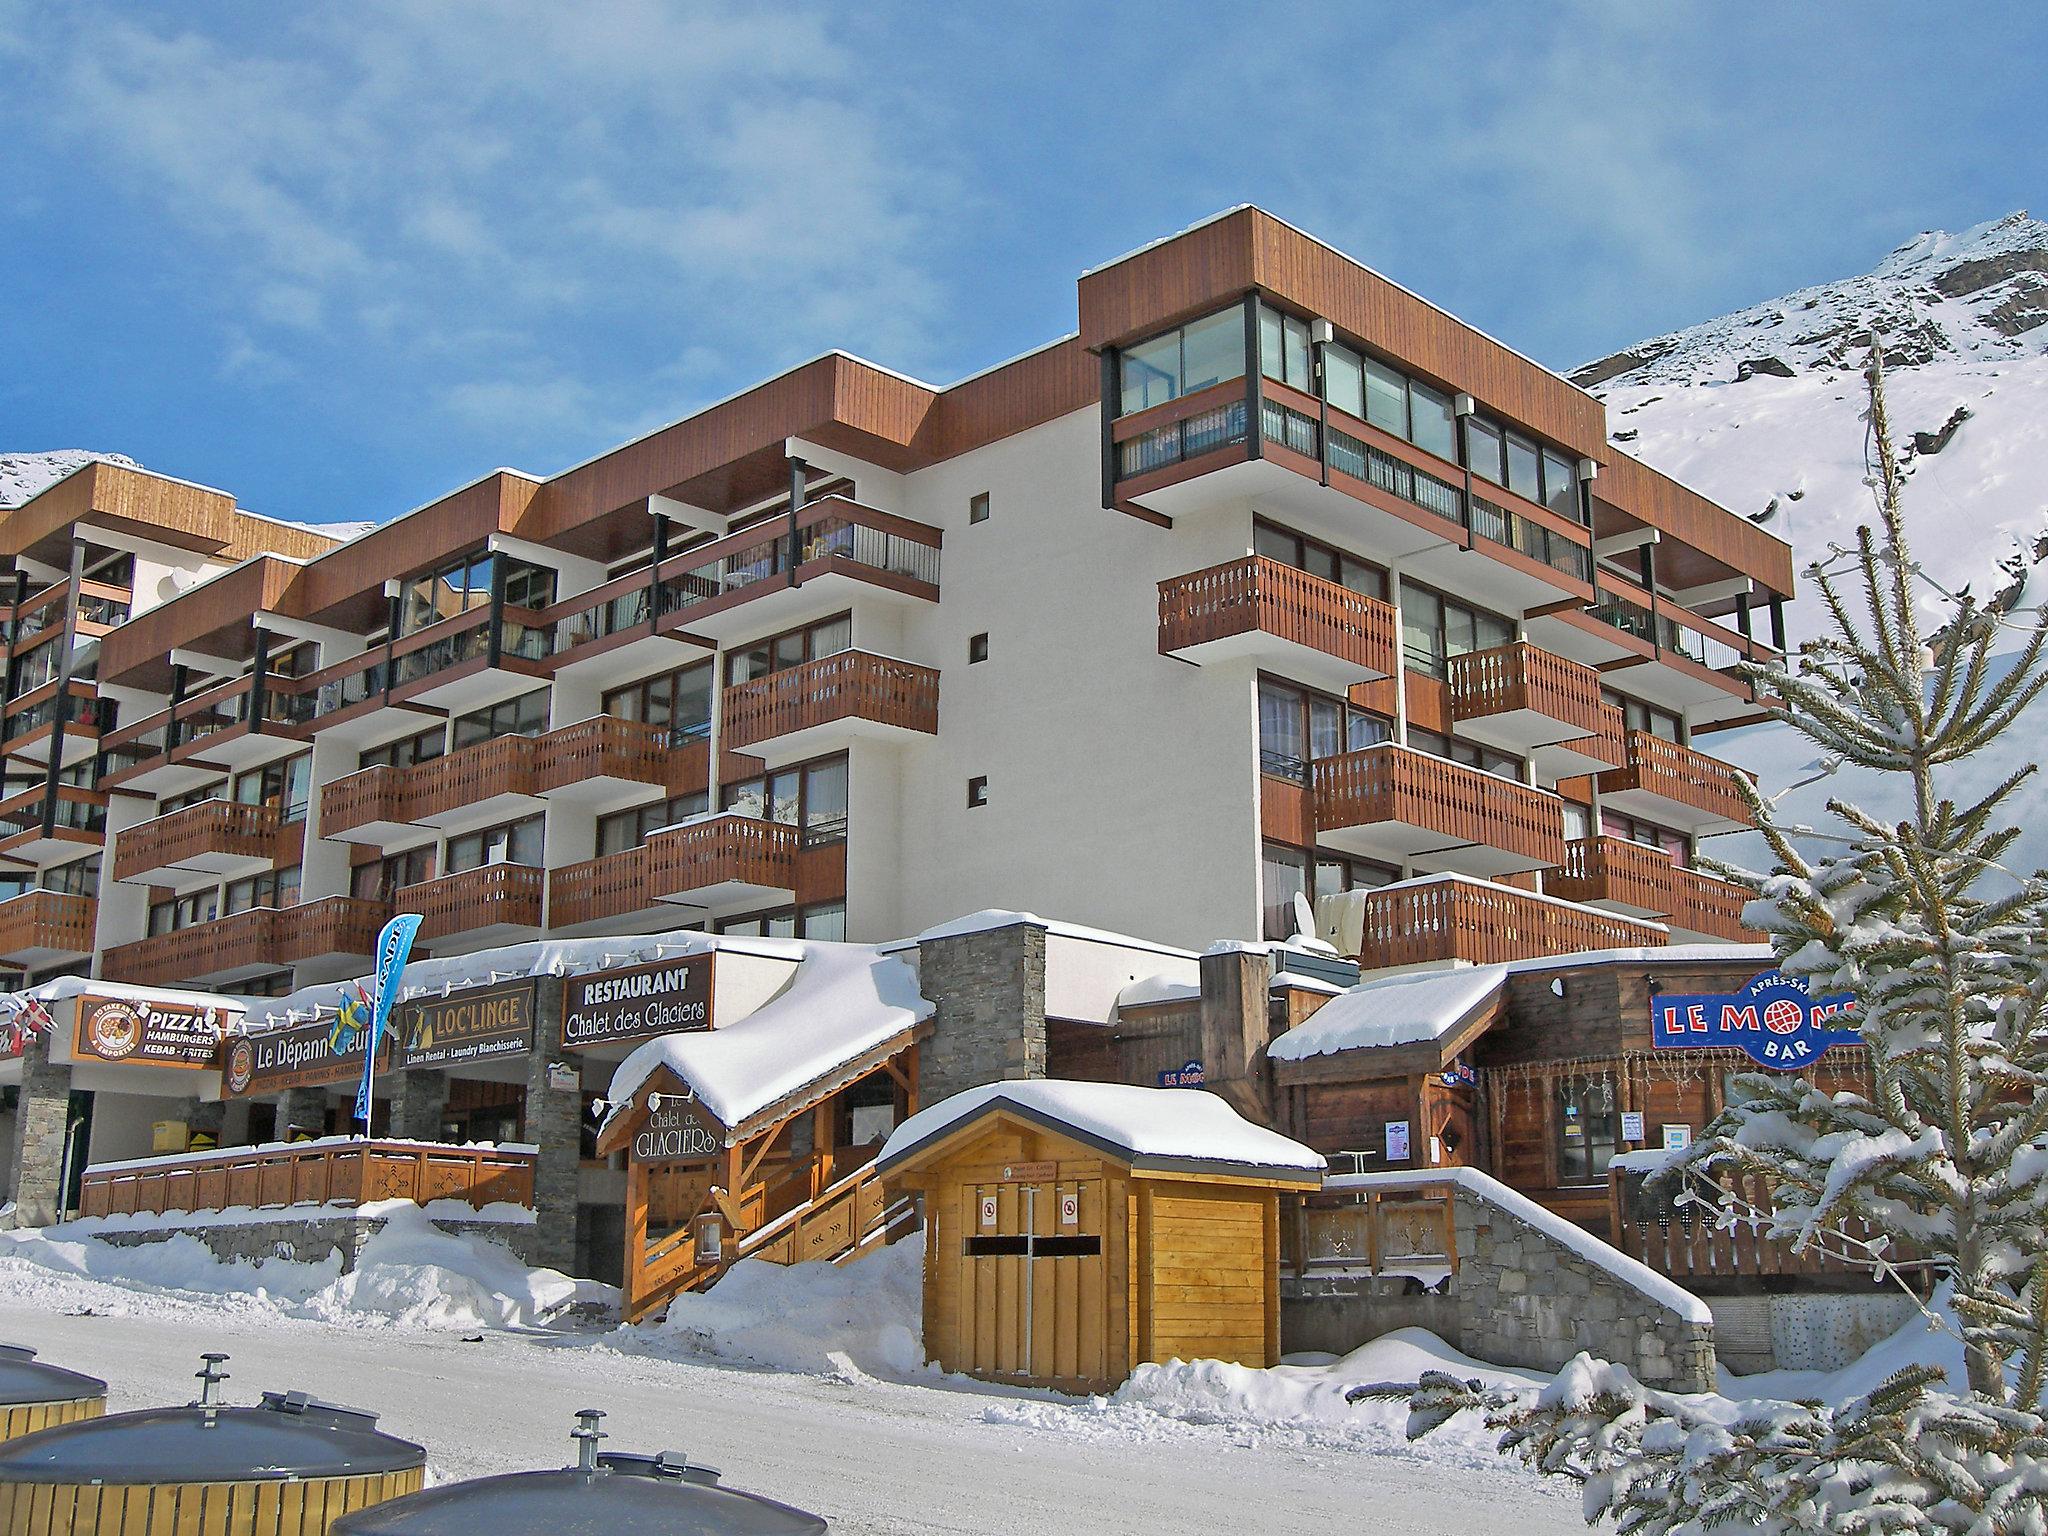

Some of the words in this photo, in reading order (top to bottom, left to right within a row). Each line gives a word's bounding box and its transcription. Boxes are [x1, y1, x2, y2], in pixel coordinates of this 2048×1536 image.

[584, 967, 689, 1005] RESTAURANT
[102, 1003, 120, 1011] TAKE
[121, 1004, 138, 1019] AWAY
[436, 997, 520, 1036] LOC'LINGE
[566, 1010, 610, 1038] Chalet
[614, 1007, 641, 1031] des
[645, 1001, 705, 1027] Glaciers
[1664, 1004, 1708, 1034] LE
[98, 1042, 136, 1057] EMPORTER
[146, 1031, 214, 1046] HAMBURGERS
[407, 1053, 425, 1065] Linen
[426, 1050, 446, 1062] Rental
[451, 1045, 478, 1058] Laundry
[479, 1037, 523, 1053] Blanchisserie
[1764, 1040, 1812, 1061] BAR
[144, 1045, 176, 1056] KEBAB
[182, 1047, 214, 1059] FRITES
[257, 1044, 273, 1069] Le
[636, 1128, 716, 1157] GLACIERS
